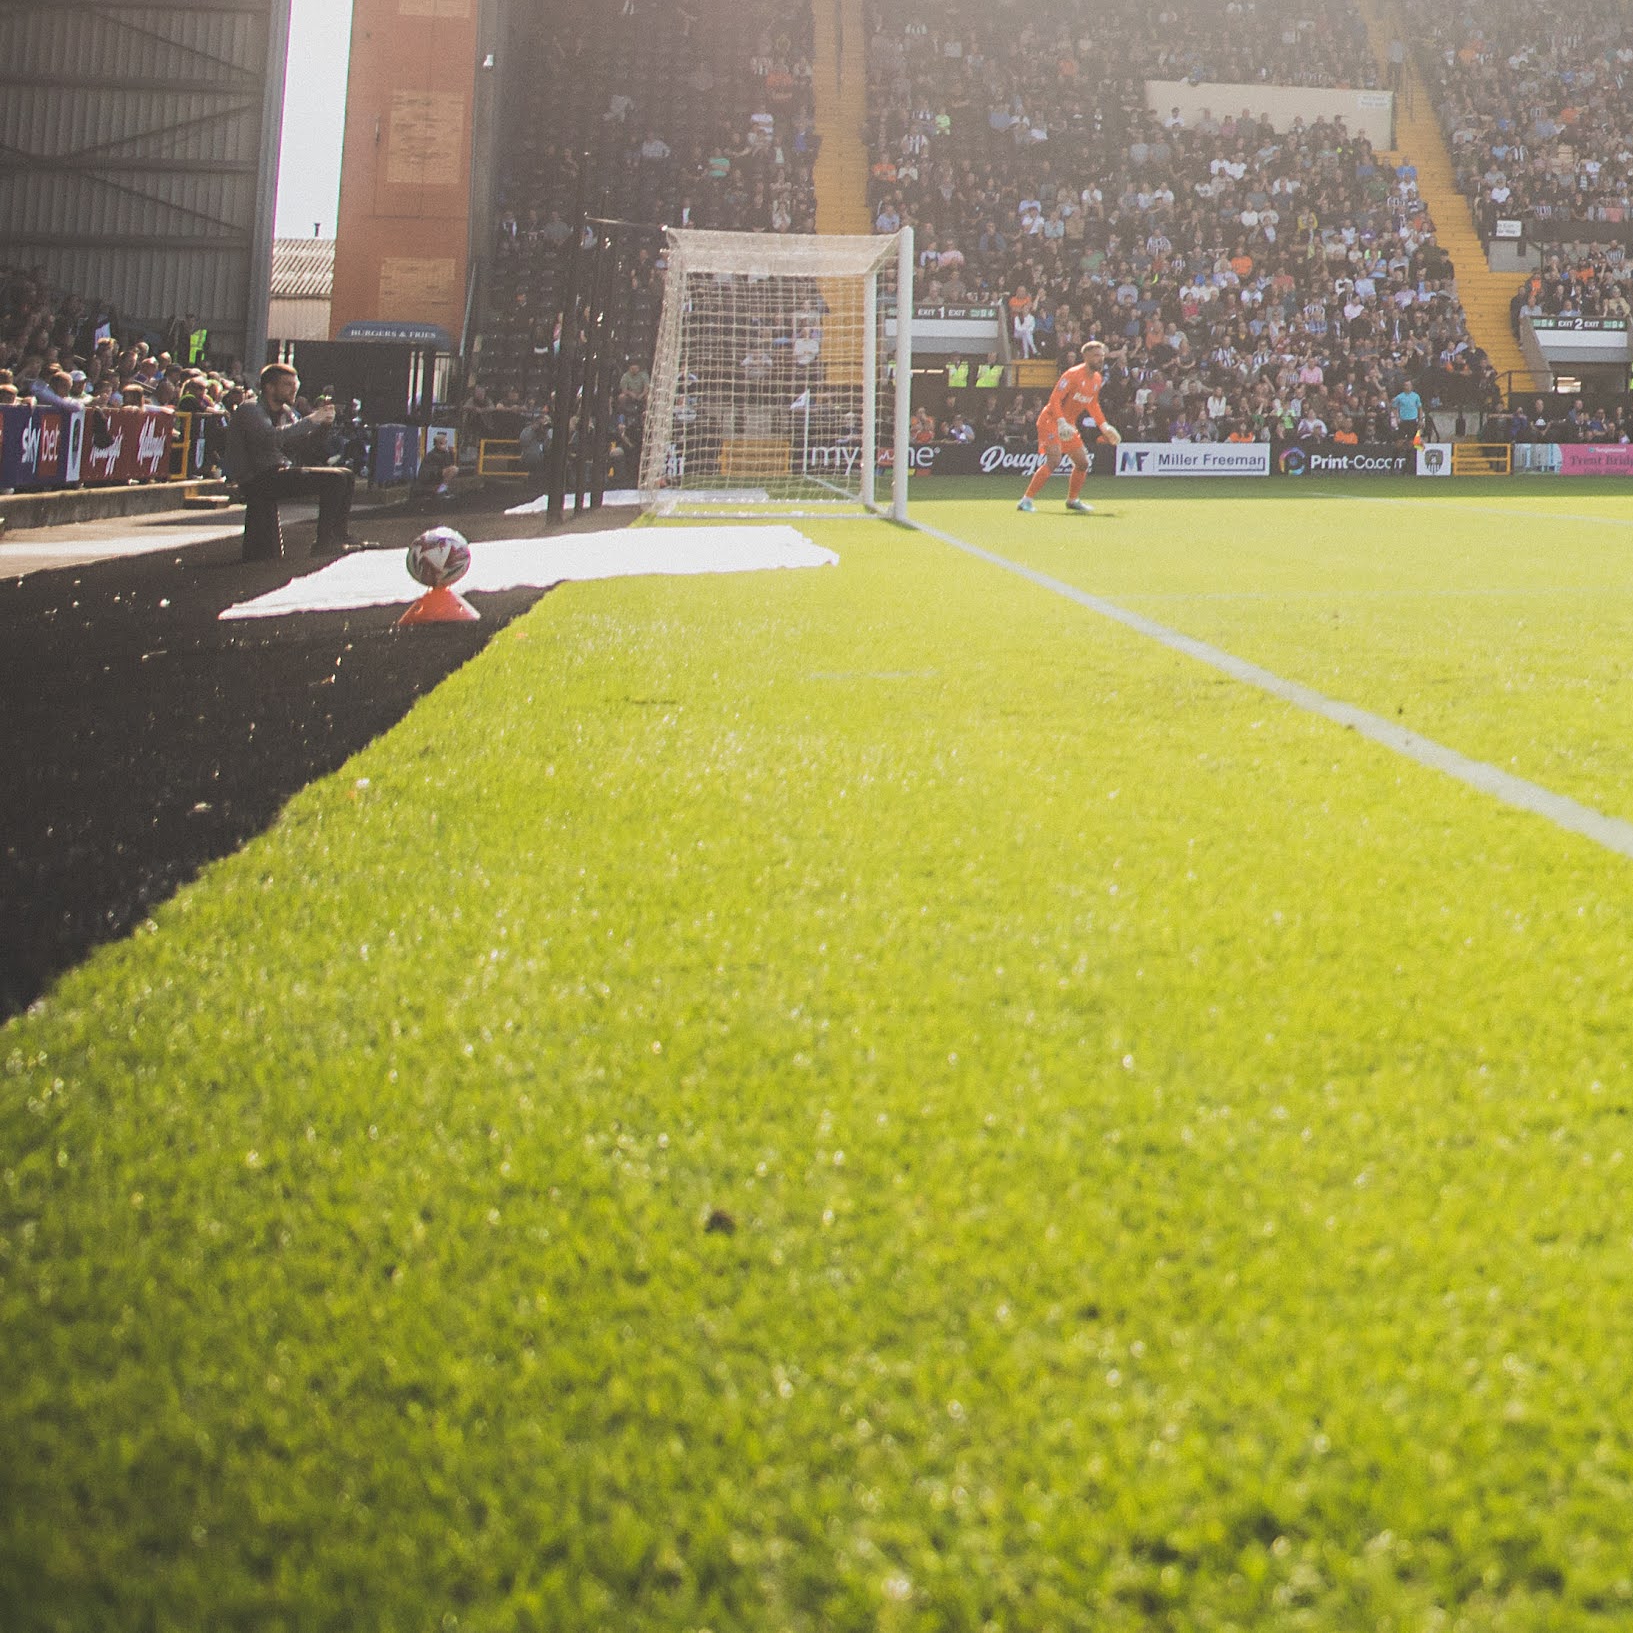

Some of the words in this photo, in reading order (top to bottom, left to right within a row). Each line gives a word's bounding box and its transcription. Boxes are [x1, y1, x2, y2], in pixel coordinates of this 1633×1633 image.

[918, 308, 936, 316] EXIT
[938, 306, 945, 318] 1
[948, 309, 966, 317] EXIT
[1574, 318, 1583, 330] 2
[351, 329, 397, 337] BURGERS
[409, 331, 436, 339] FRIES
[22, 417, 41, 474] sky
[41, 419, 60, 462] bet
[1158, 454, 1198, 466] Miller
[1203, 454, 1265, 466] Freeman
[1570, 455, 1602, 466] Trent
